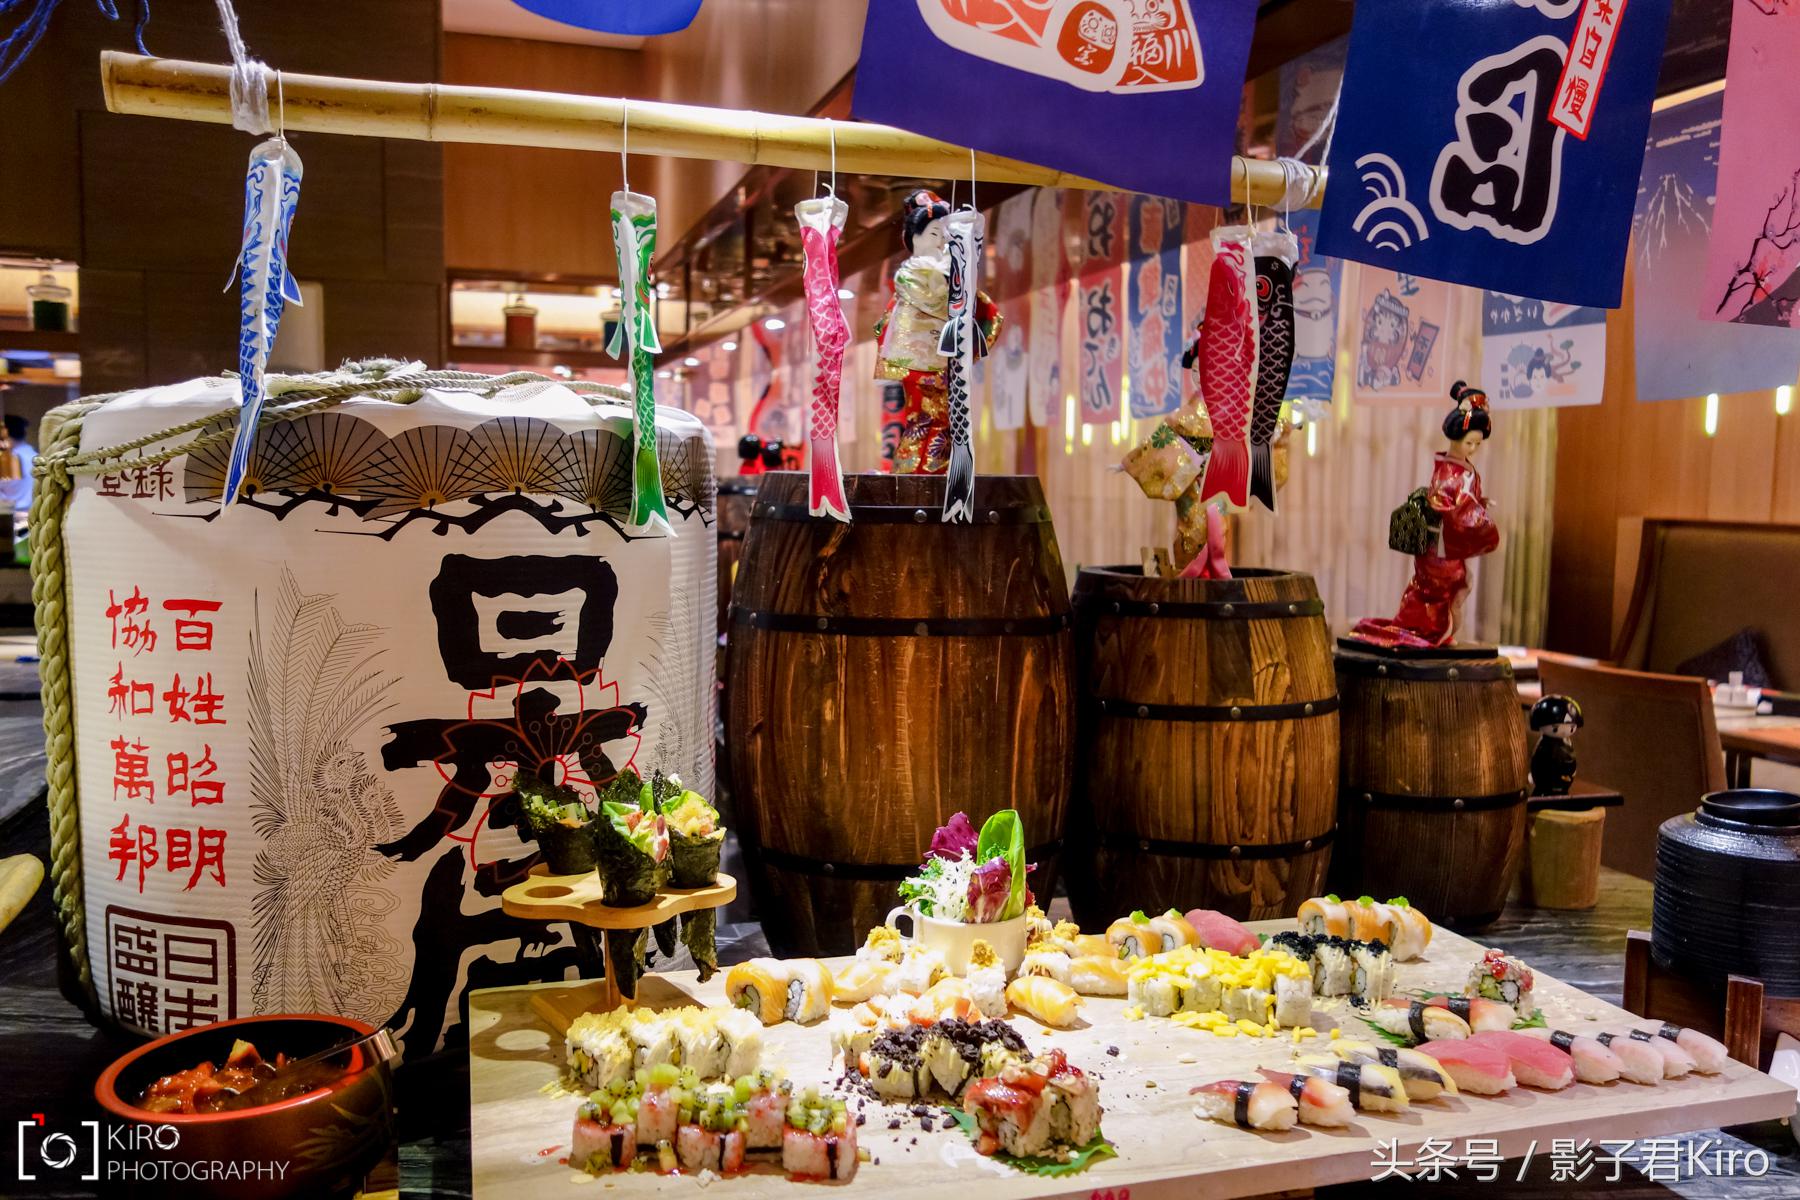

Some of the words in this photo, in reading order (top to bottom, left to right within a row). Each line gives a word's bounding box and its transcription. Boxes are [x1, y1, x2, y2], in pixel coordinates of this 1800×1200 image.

[1430, 0, 1578, 245] 司
[105, 585, 161, 894] 協和萬邦
[162, 598, 228, 892] 百姓昭明
